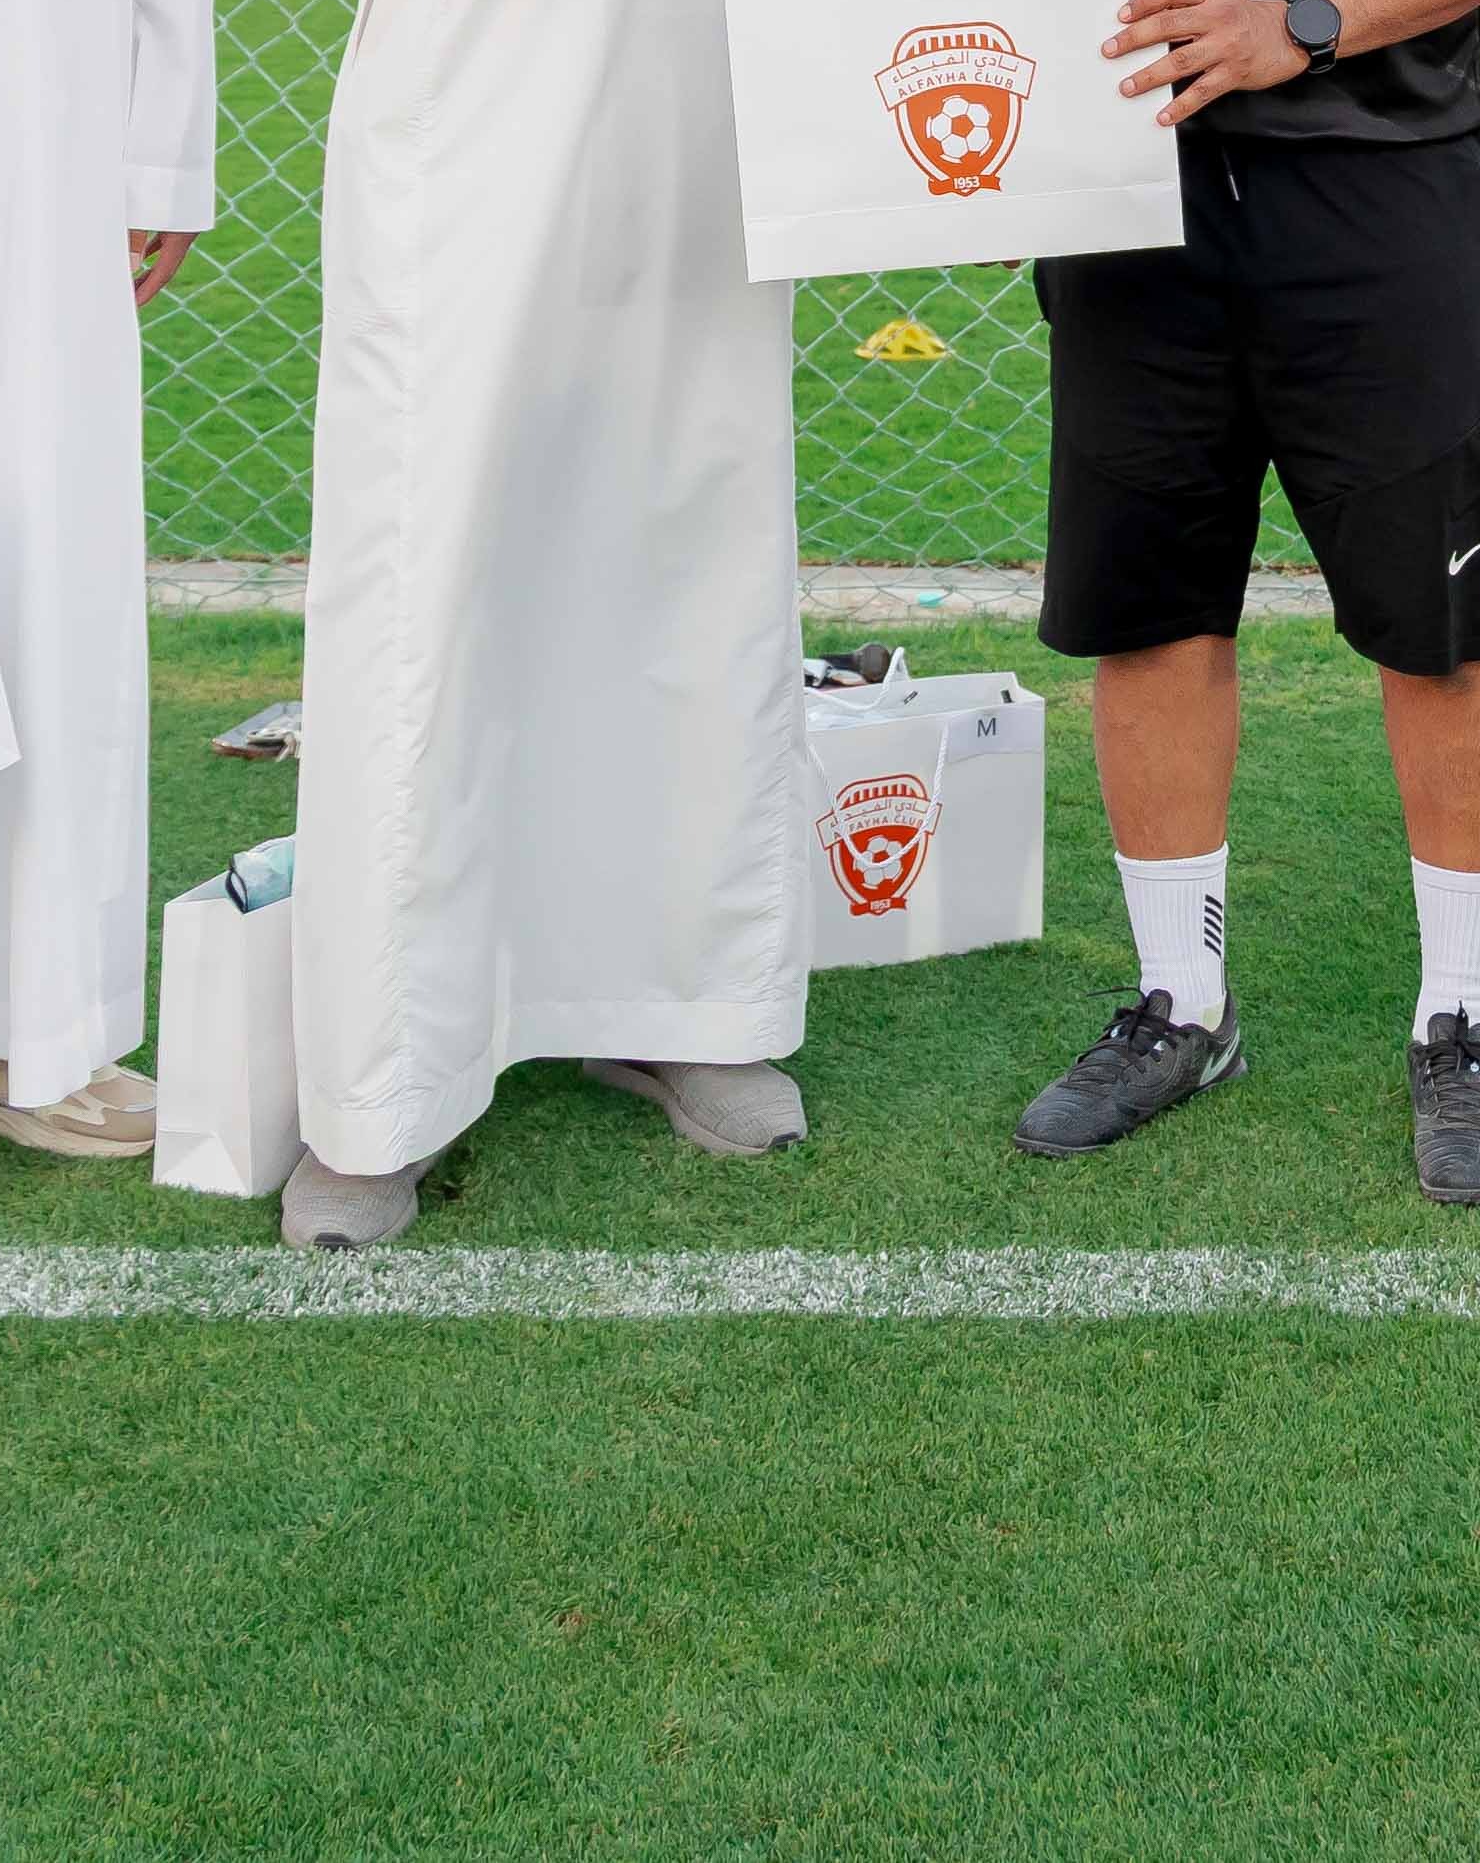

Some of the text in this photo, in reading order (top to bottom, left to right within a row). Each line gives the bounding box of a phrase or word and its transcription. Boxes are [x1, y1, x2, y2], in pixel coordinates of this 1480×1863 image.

[974, 54, 1020, 73] نادي
[898, 71, 1014, 99] ALFAYHA CLUB
[953, 176, 981, 189] 1953
[977, 717, 997, 738] M
